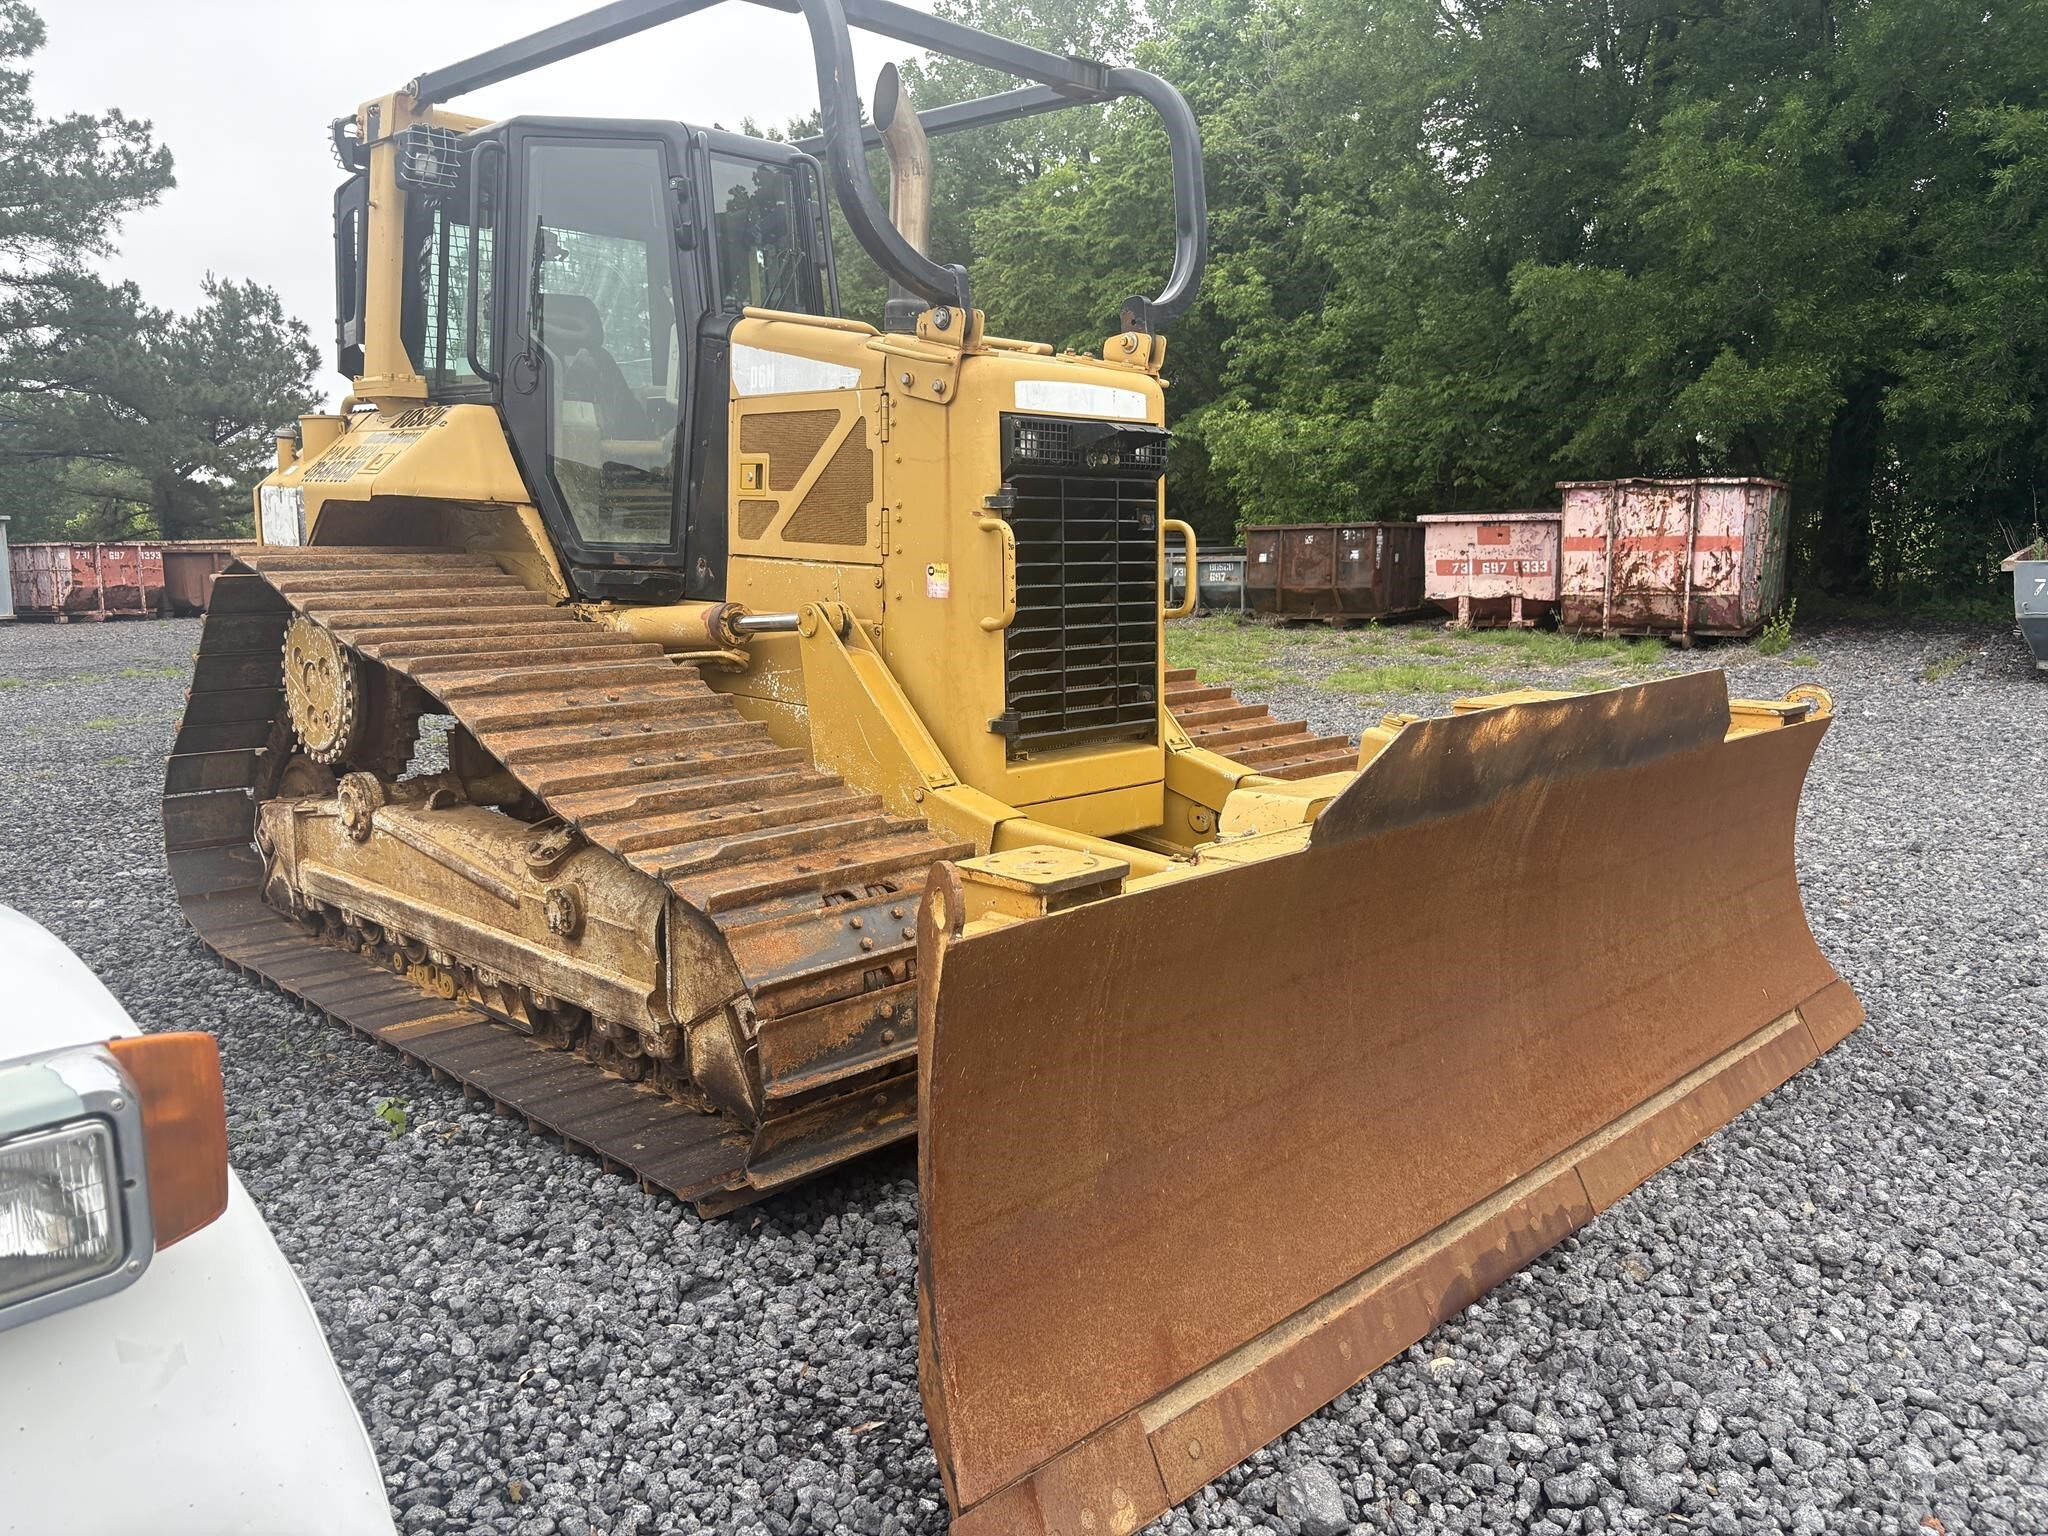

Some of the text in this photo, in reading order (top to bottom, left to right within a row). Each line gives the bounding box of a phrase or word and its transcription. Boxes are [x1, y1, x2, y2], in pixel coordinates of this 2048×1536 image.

[750, 364, 776, 388] D6N
[75, 551, 90, 560] 731
[109, 551, 125, 560] 697
[1482, 561, 1507, 574] 697
[1210, 572, 1226, 582] 697
[2034, 578, 2048, 596] 7
